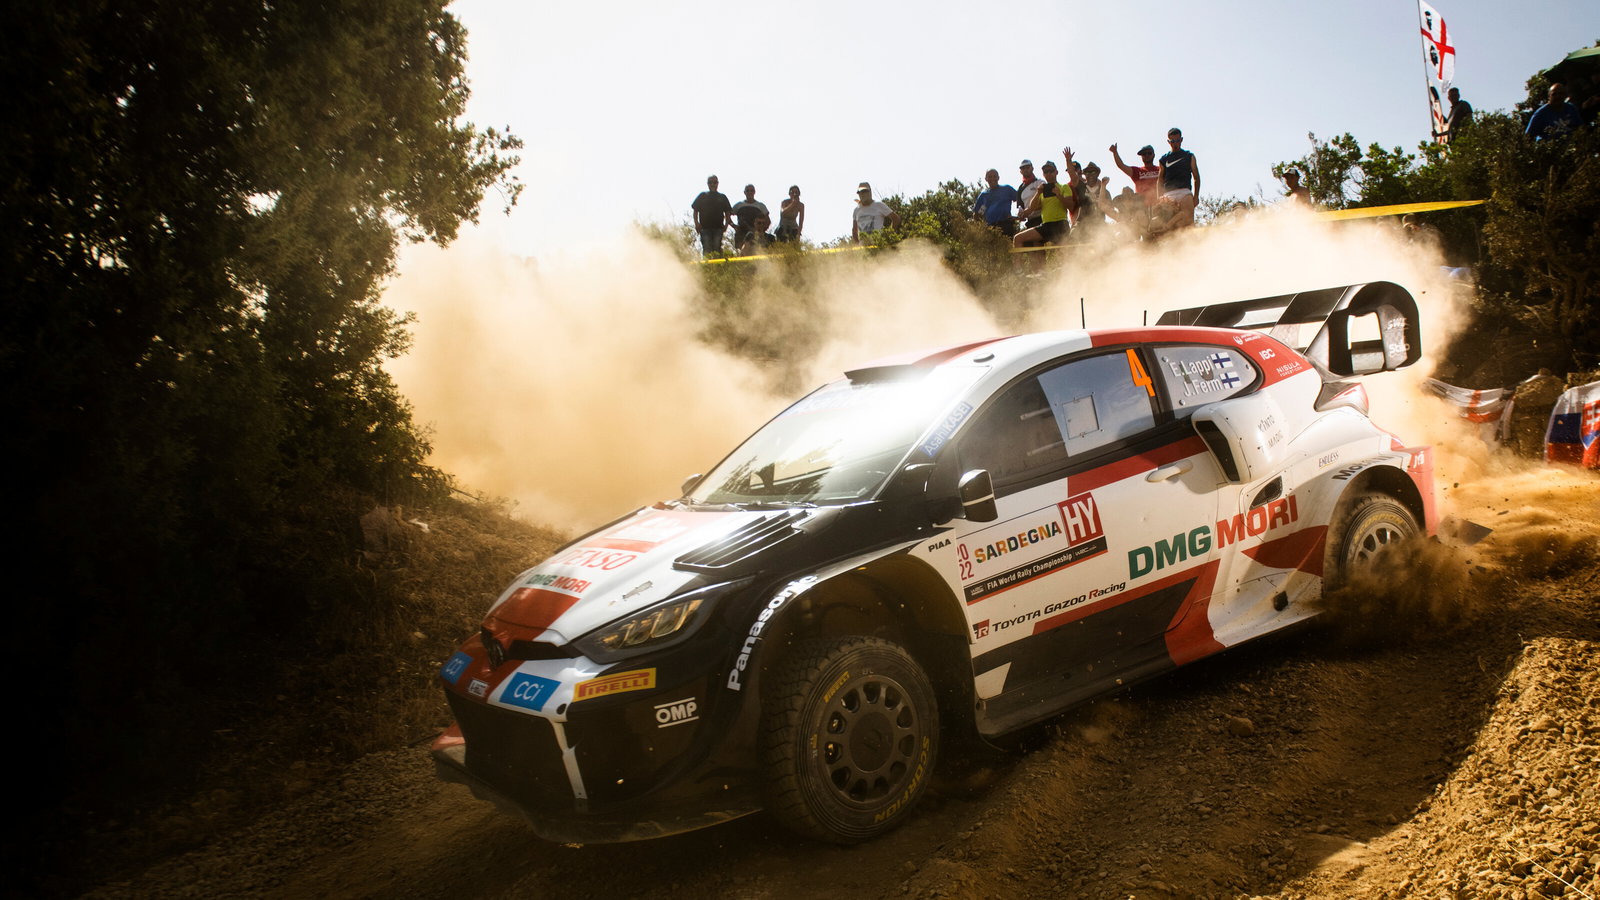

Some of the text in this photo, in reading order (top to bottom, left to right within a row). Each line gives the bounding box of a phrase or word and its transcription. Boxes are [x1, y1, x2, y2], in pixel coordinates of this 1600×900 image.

[1126, 348, 1156, 397] 4
[1169, 355, 1214, 377] E.Lappi
[1276, 361, 1301, 373] NISULA
[1183, 378, 1222, 396] J.Ferm
[1318, 451, 1339, 468] ENDLESS
[1062, 497, 1097, 542] HY
[928, 538, 951, 552] PIAA
[974, 521, 1062, 563] SARDEGNA
[1128, 495, 1299, 580] DMG MORI
[551, 550, 638, 571] DENSO
[986, 581, 998, 591] FIA
[998, 573, 1016, 586] World
[1017, 567, 1032, 579] Rally
[1033, 553, 1073, 572] Championship
[550, 576, 591, 593] MORI
[992, 610, 1041, 633] TOYOTA
[1044, 595, 1086, 615] GAZOO
[1088, 582, 1126, 600] Racing
[727, 575, 818, 691] Panasonic
[578, 672, 650, 698] PIRELLI
[655, 701, 698, 723] OMP
[873, 735, 930, 823] SCORPION
